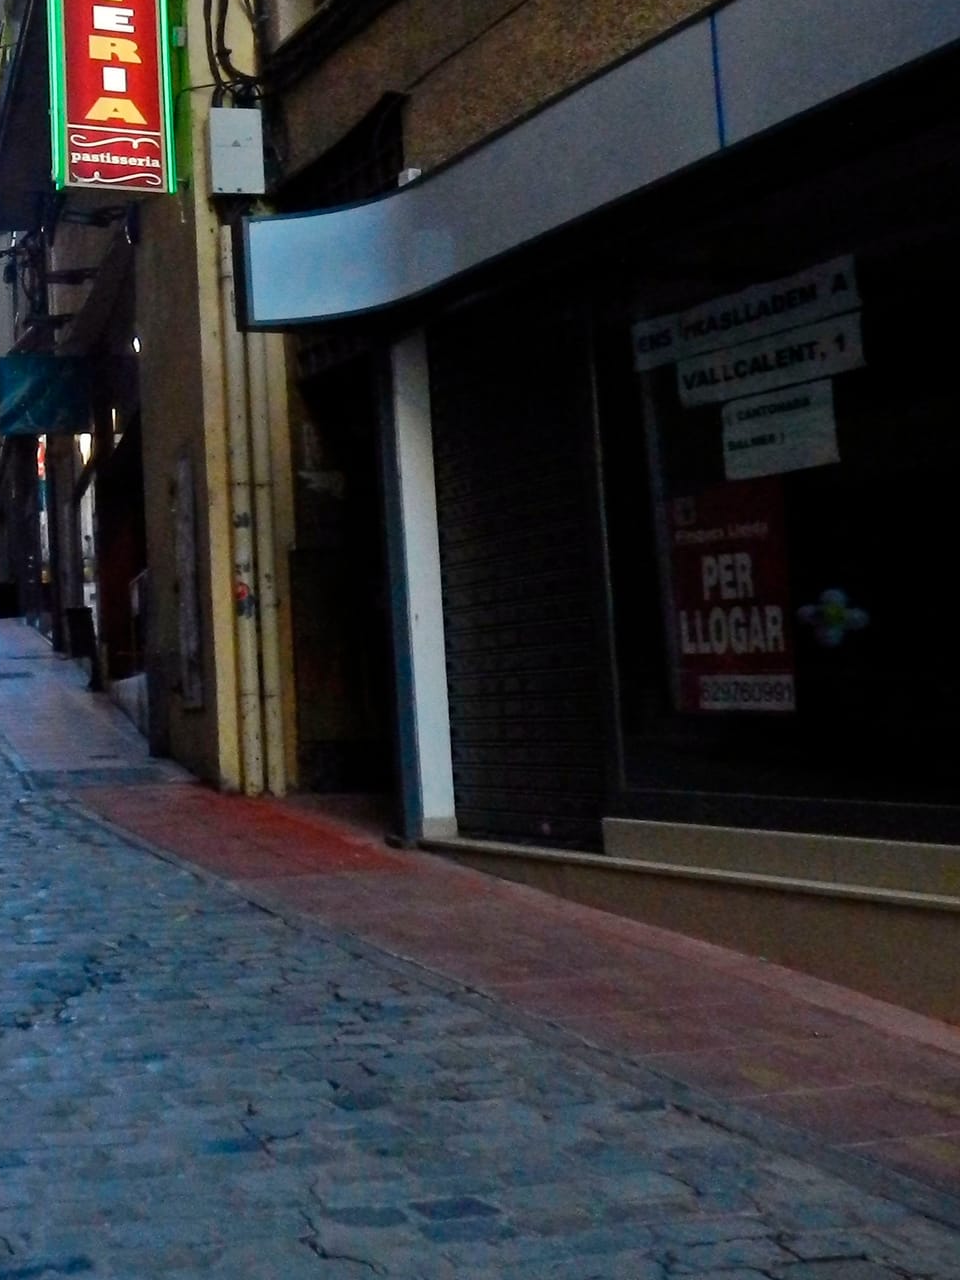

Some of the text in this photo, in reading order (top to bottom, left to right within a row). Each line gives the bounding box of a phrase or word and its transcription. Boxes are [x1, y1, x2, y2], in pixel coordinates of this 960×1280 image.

[70, 149, 161, 169] pastisseria
[638, 328, 673, 353] ENS
[831, 272, 847, 294] A
[682, 332, 846, 391] VALLCALENT, 1
[701, 552, 754, 600] PER
[679, 604, 785, 655] LLOGAR
